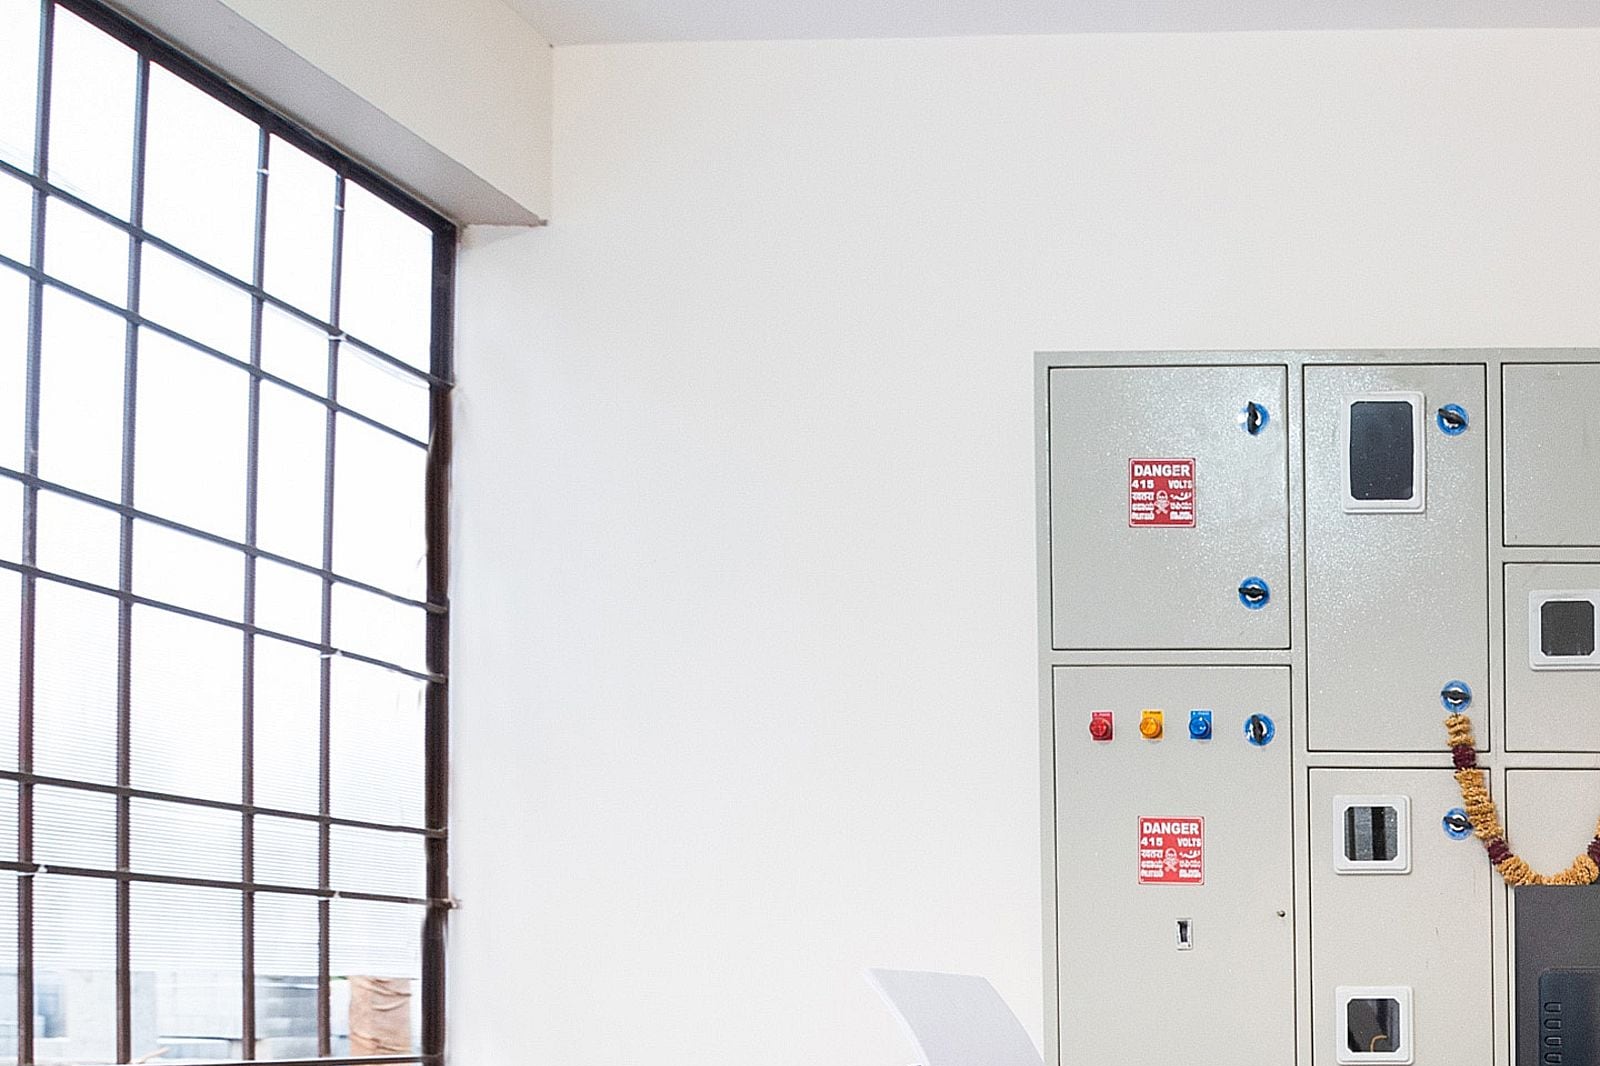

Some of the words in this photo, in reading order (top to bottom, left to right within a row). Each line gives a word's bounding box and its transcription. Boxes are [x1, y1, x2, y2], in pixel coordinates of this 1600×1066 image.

[1134, 464, 1191, 477] DANGER
[1131, 479, 1154, 489] 415
[1168, 479, 1193, 489] VOLTS
[1143, 822, 1199, 835] DANGER
[1140, 837, 1164, 847] 415
[1177, 837, 1202, 847] VOLTS
